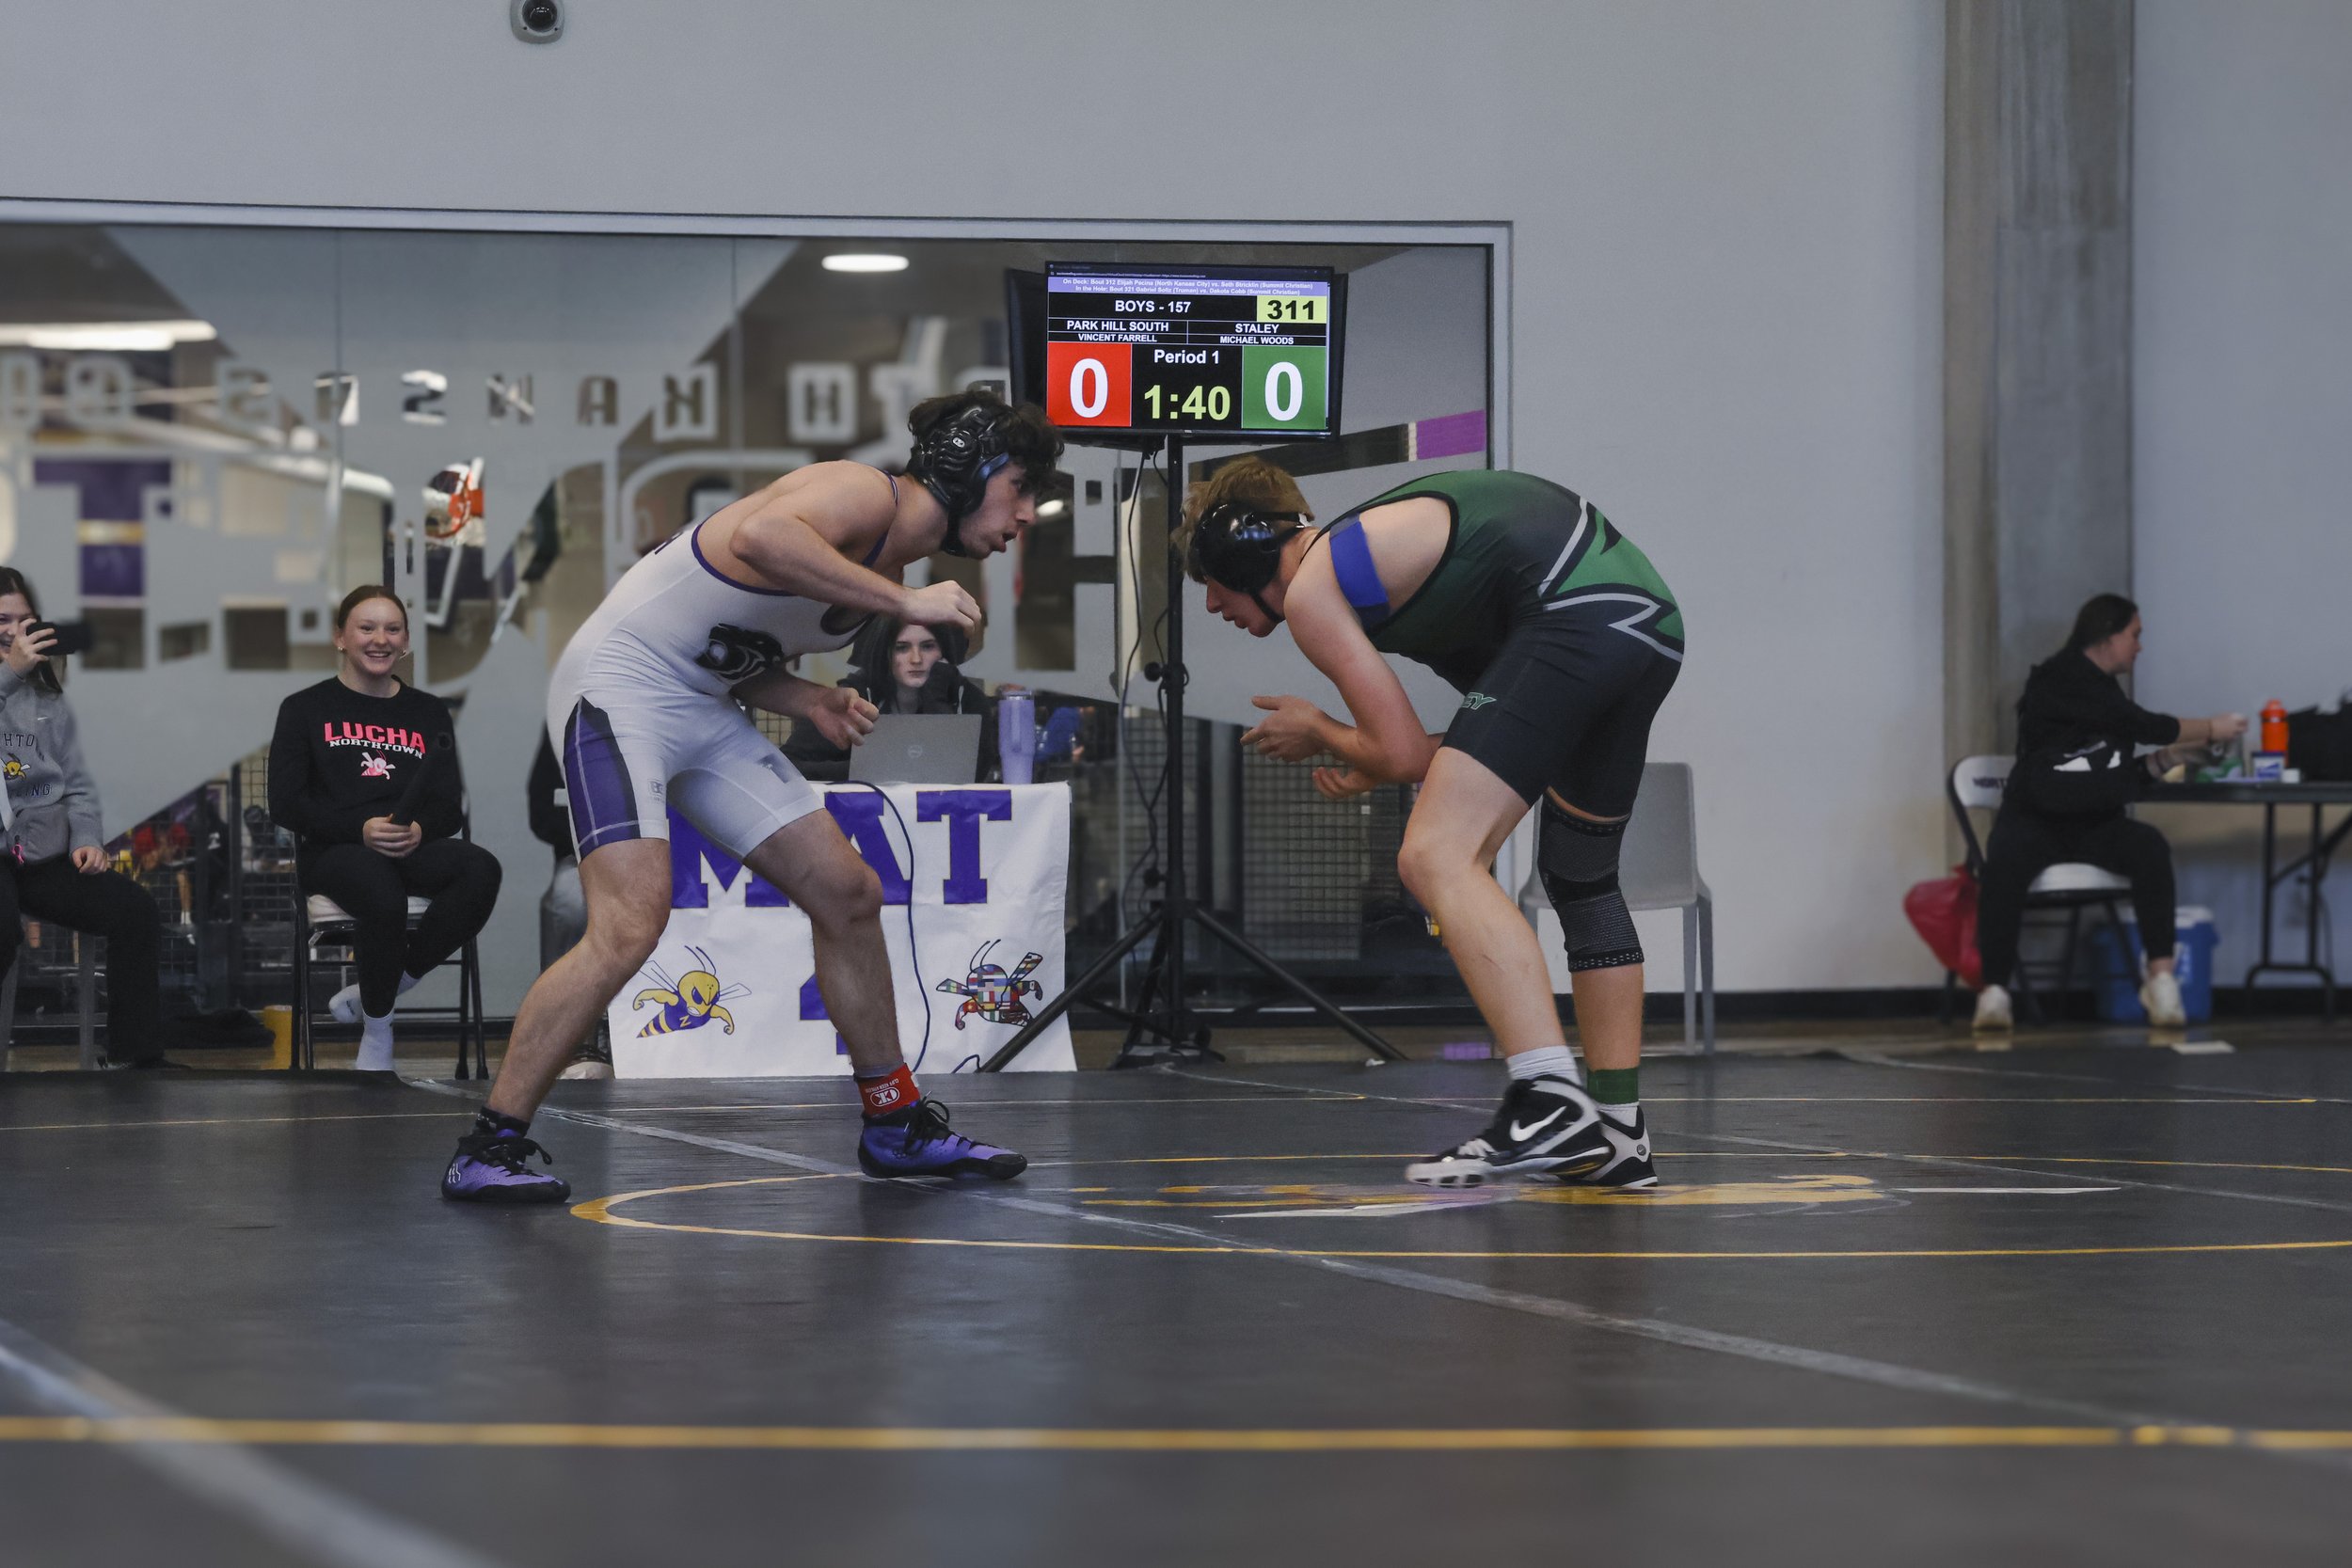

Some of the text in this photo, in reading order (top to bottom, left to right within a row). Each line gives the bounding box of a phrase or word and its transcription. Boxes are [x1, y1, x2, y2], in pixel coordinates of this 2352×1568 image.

[1115, 300, 1155, 312] BOYS
[1168, 301, 1191, 313] 157
[1267, 300, 1314, 320] 311
[1067, 320, 1169, 332] PARK HILL SOUTH
[1234, 323, 1279, 334] STALEY
[1078, 333, 1157, 342] VINCENT FARRELL
[1219, 336, 1295, 345] MICHAEL WOODS
[1153, 349, 1219, 364] Period 1
[1070, 357, 1108, 419] 0
[1264, 361, 1303, 421] 0
[1144, 384, 1231, 420] 1:40
[324, 721, 426, 754] LUCHA
[329, 738, 423, 760] NORTHTOWN
[666, 790, 1012, 909] MAT
